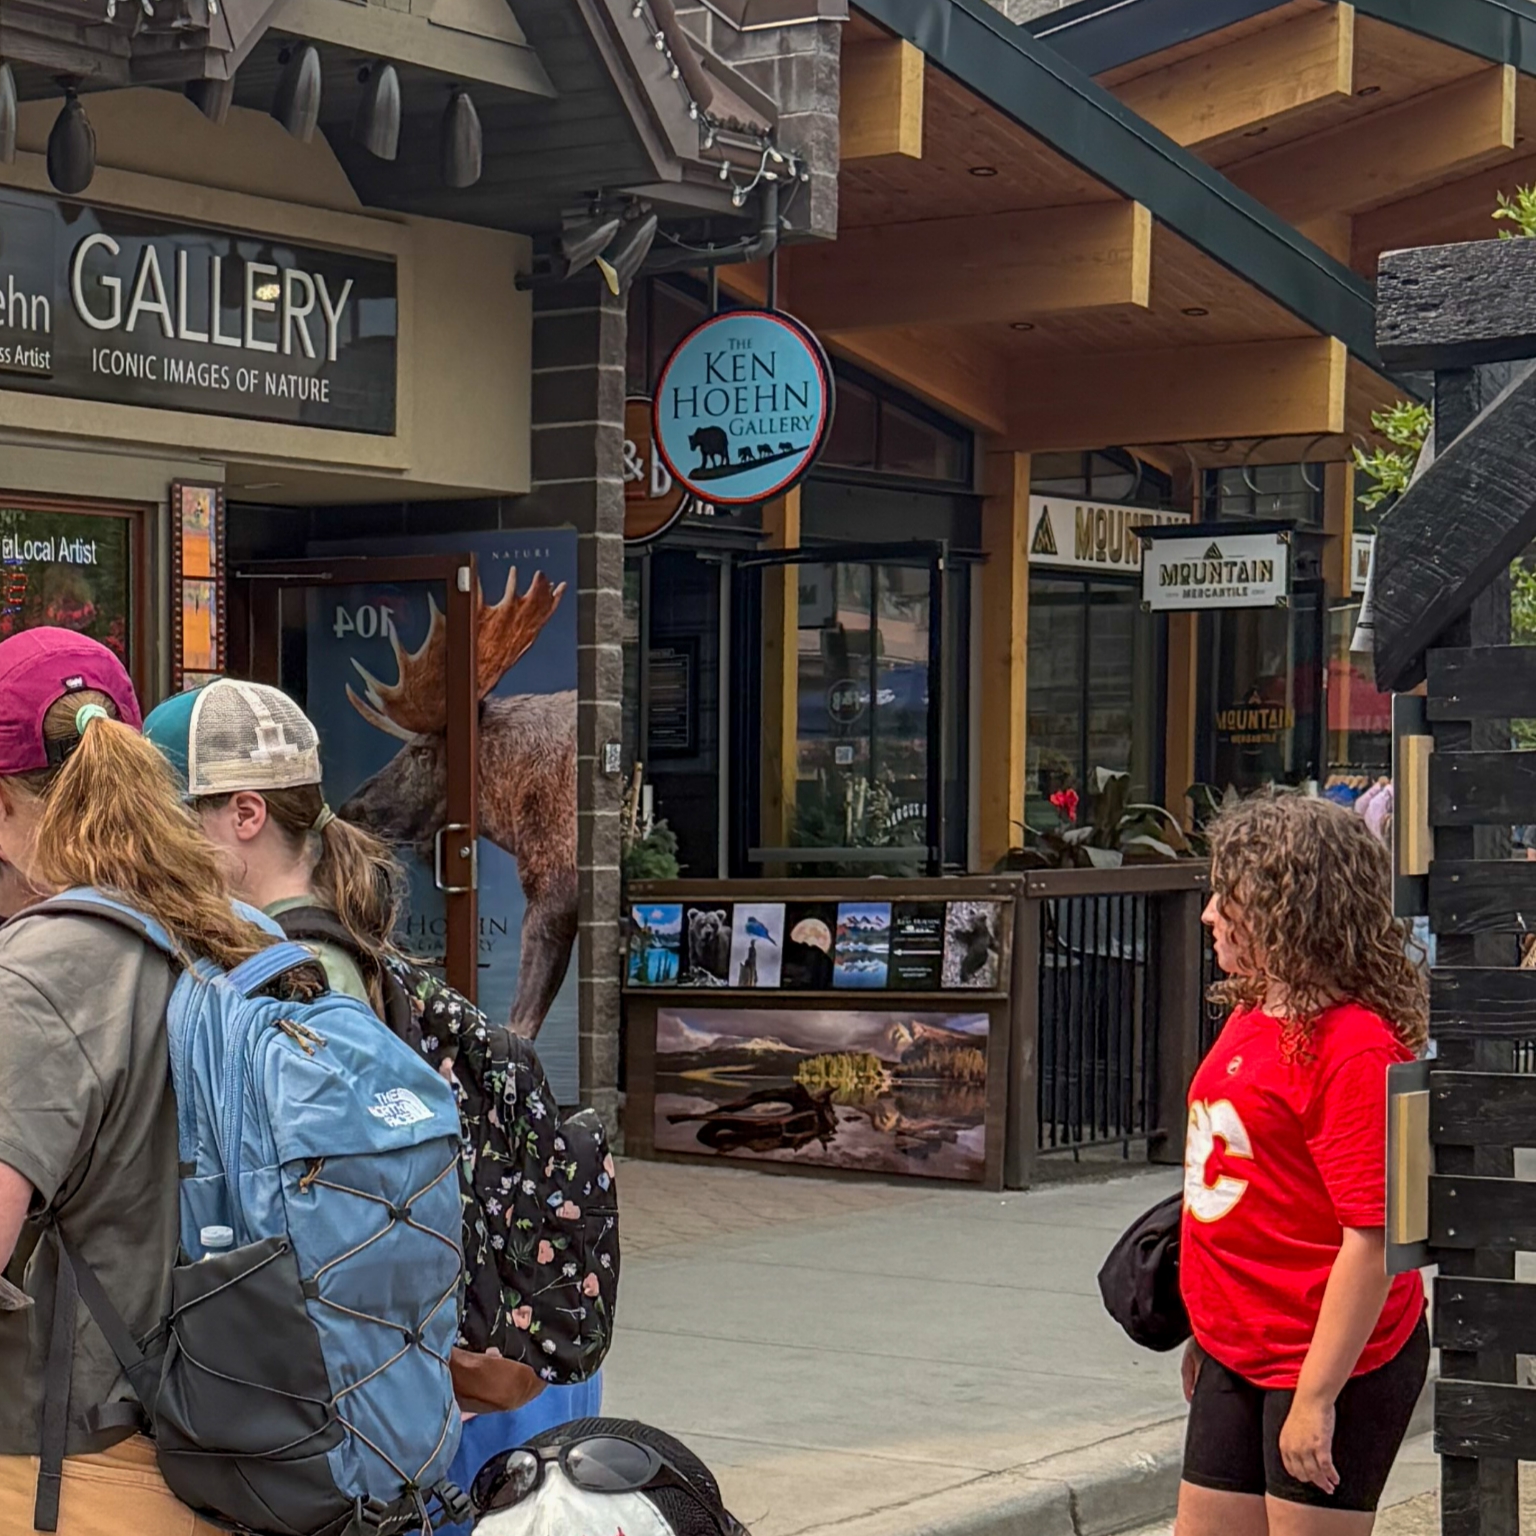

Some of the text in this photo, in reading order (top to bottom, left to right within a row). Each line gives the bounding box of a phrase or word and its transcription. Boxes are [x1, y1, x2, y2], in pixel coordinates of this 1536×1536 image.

[72, 232, 354, 361] GALLERY
[14, 340, 51, 370] Artist
[728, 338, 752, 350] THE
[92, 347, 330, 403] ICONIC IMAGES OF NATURE
[704, 351, 776, 384] KEN
[672, 381, 810, 419] HOEHN
[729, 414, 814, 437] GALLERY
[15, 533, 55, 562] Local
[58, 536, 97, 565] Artist
[1159, 559, 1273, 586] MOUNTAIN
[1182, 587, 1248, 599] MERCANTILE
[374, 1089, 399, 1106] THE
